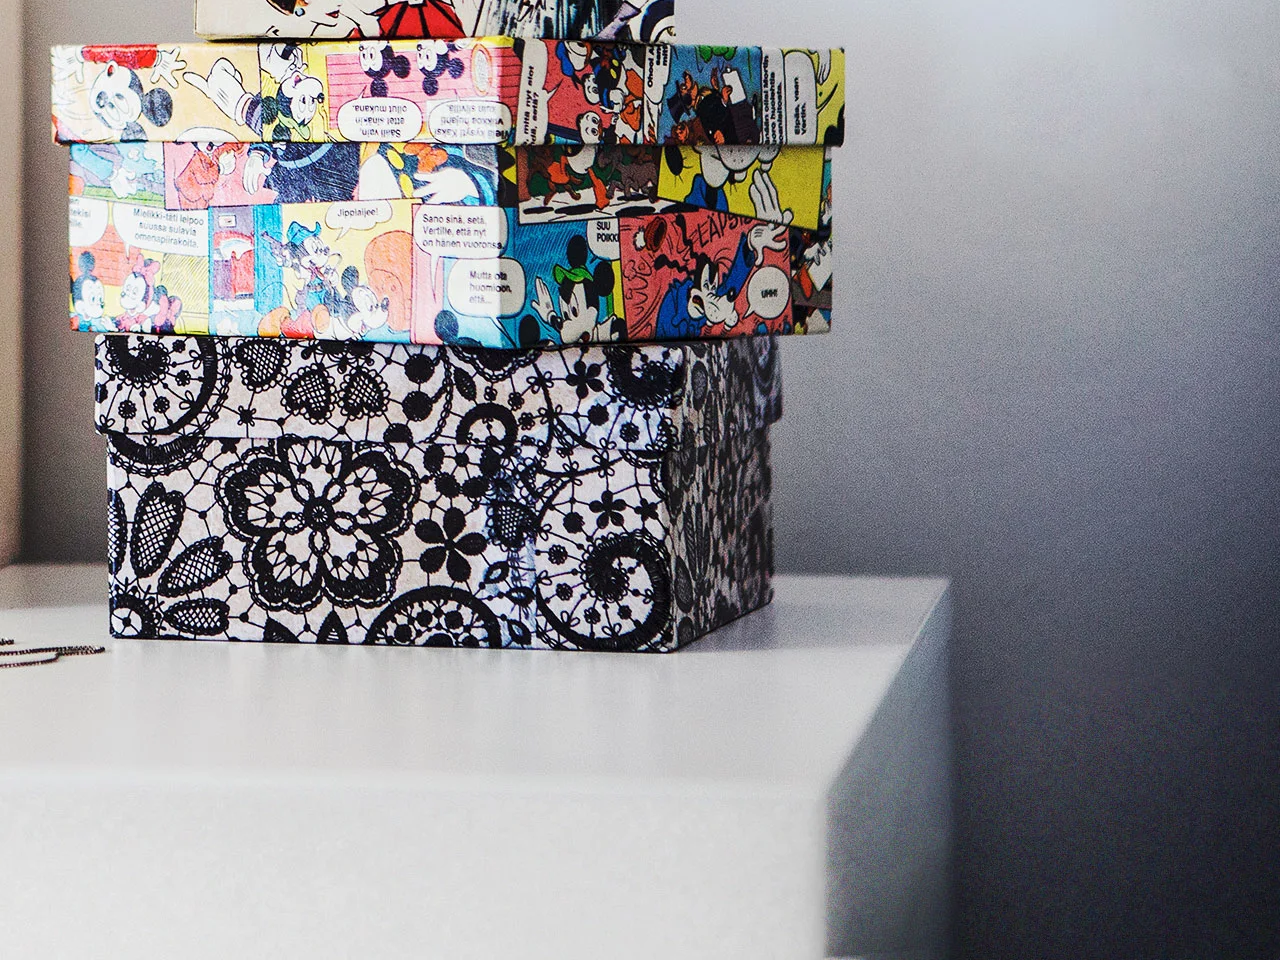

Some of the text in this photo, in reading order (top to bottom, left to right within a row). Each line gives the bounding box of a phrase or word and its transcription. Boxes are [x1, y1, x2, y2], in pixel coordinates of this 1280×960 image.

[422, 214, 444, 224] Sano
[596, 221, 611, 230] SUU
[473, 228, 487, 238] nyt
